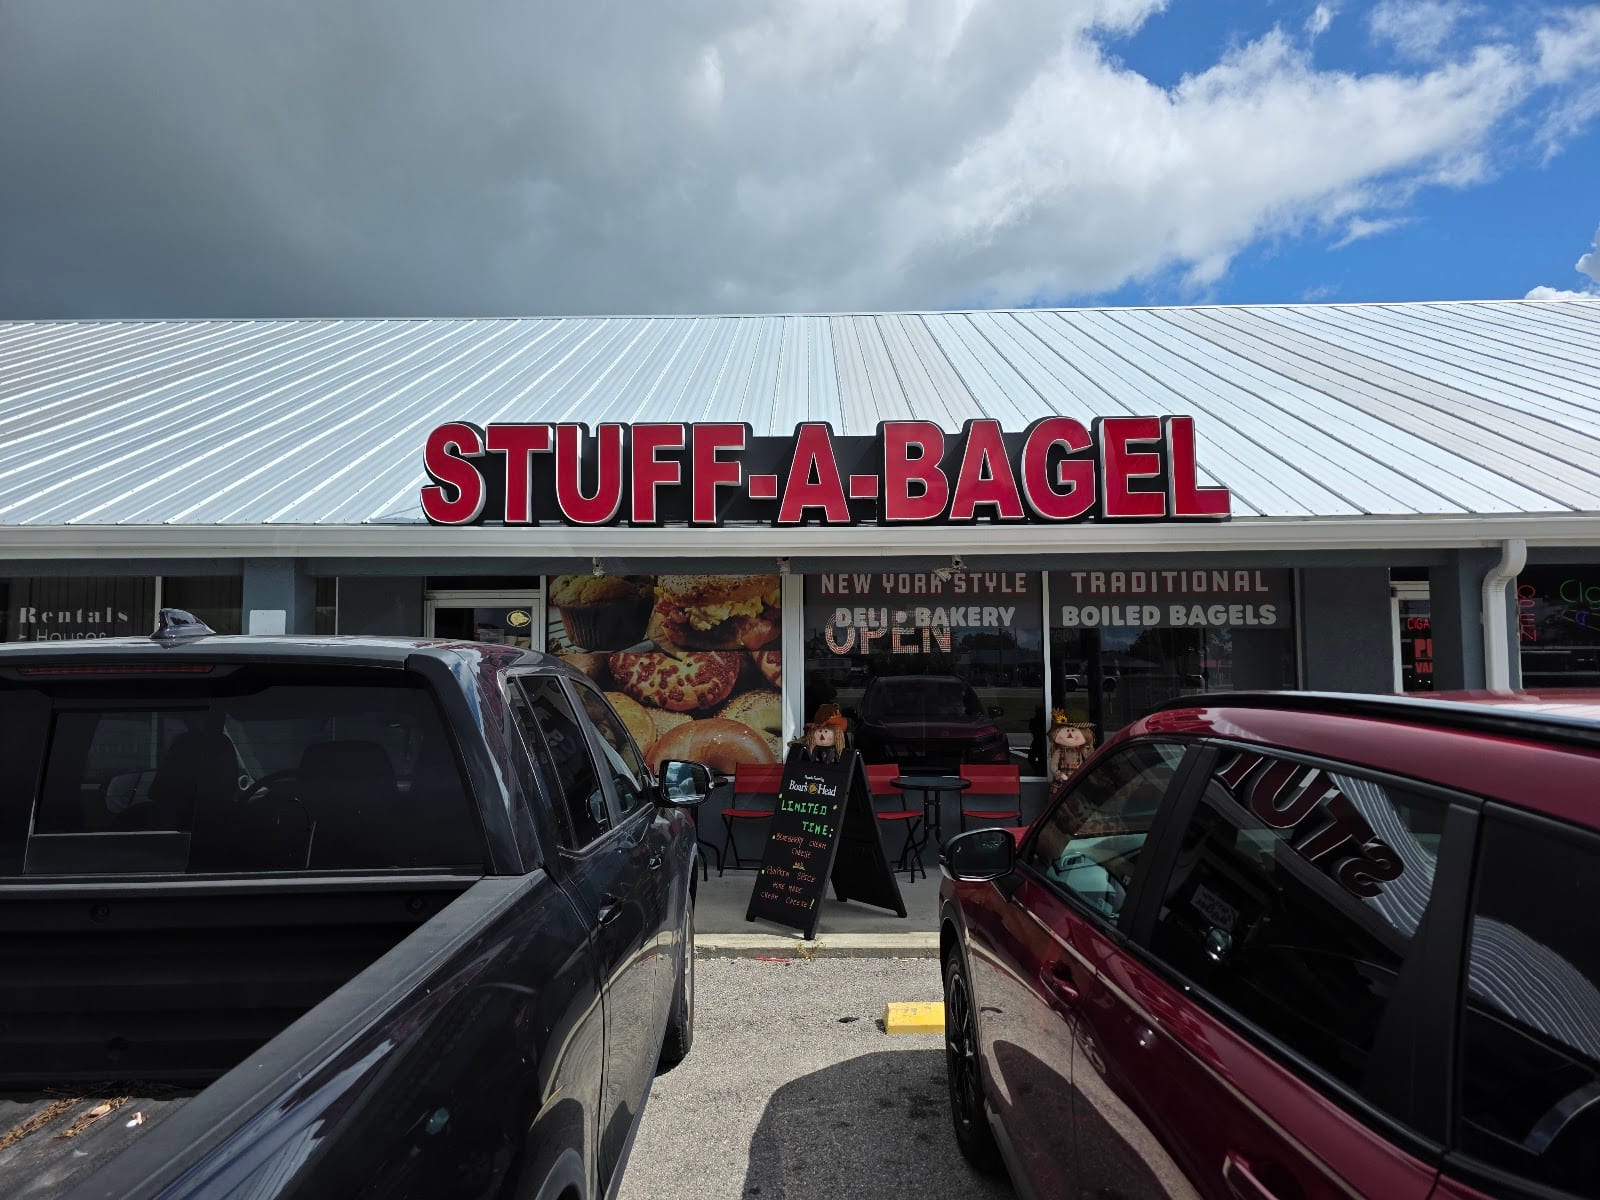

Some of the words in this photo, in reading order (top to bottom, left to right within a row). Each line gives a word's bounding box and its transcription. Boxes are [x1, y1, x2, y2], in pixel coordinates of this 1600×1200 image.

[420, 416, 1232, 525] STUFF-A-BAGEL
[820, 573, 872, 595] NEW
[882, 572, 943, 595] YORK
[954, 571, 1027, 594] STYLE
[1070, 570, 1270, 594] TRADITIONAL
[19, 607, 129, 624] Rentals
[835, 606, 888, 627] DELI
[915, 605, 1016, 627] BAKERY
[1062, 604, 1161, 627] BOILED
[1169, 603, 1277, 626] BAGELS
[824, 608, 952, 656] OPEN
[817, 783, 838, 797] Head
[781, 799, 828, 816] LIMITED
